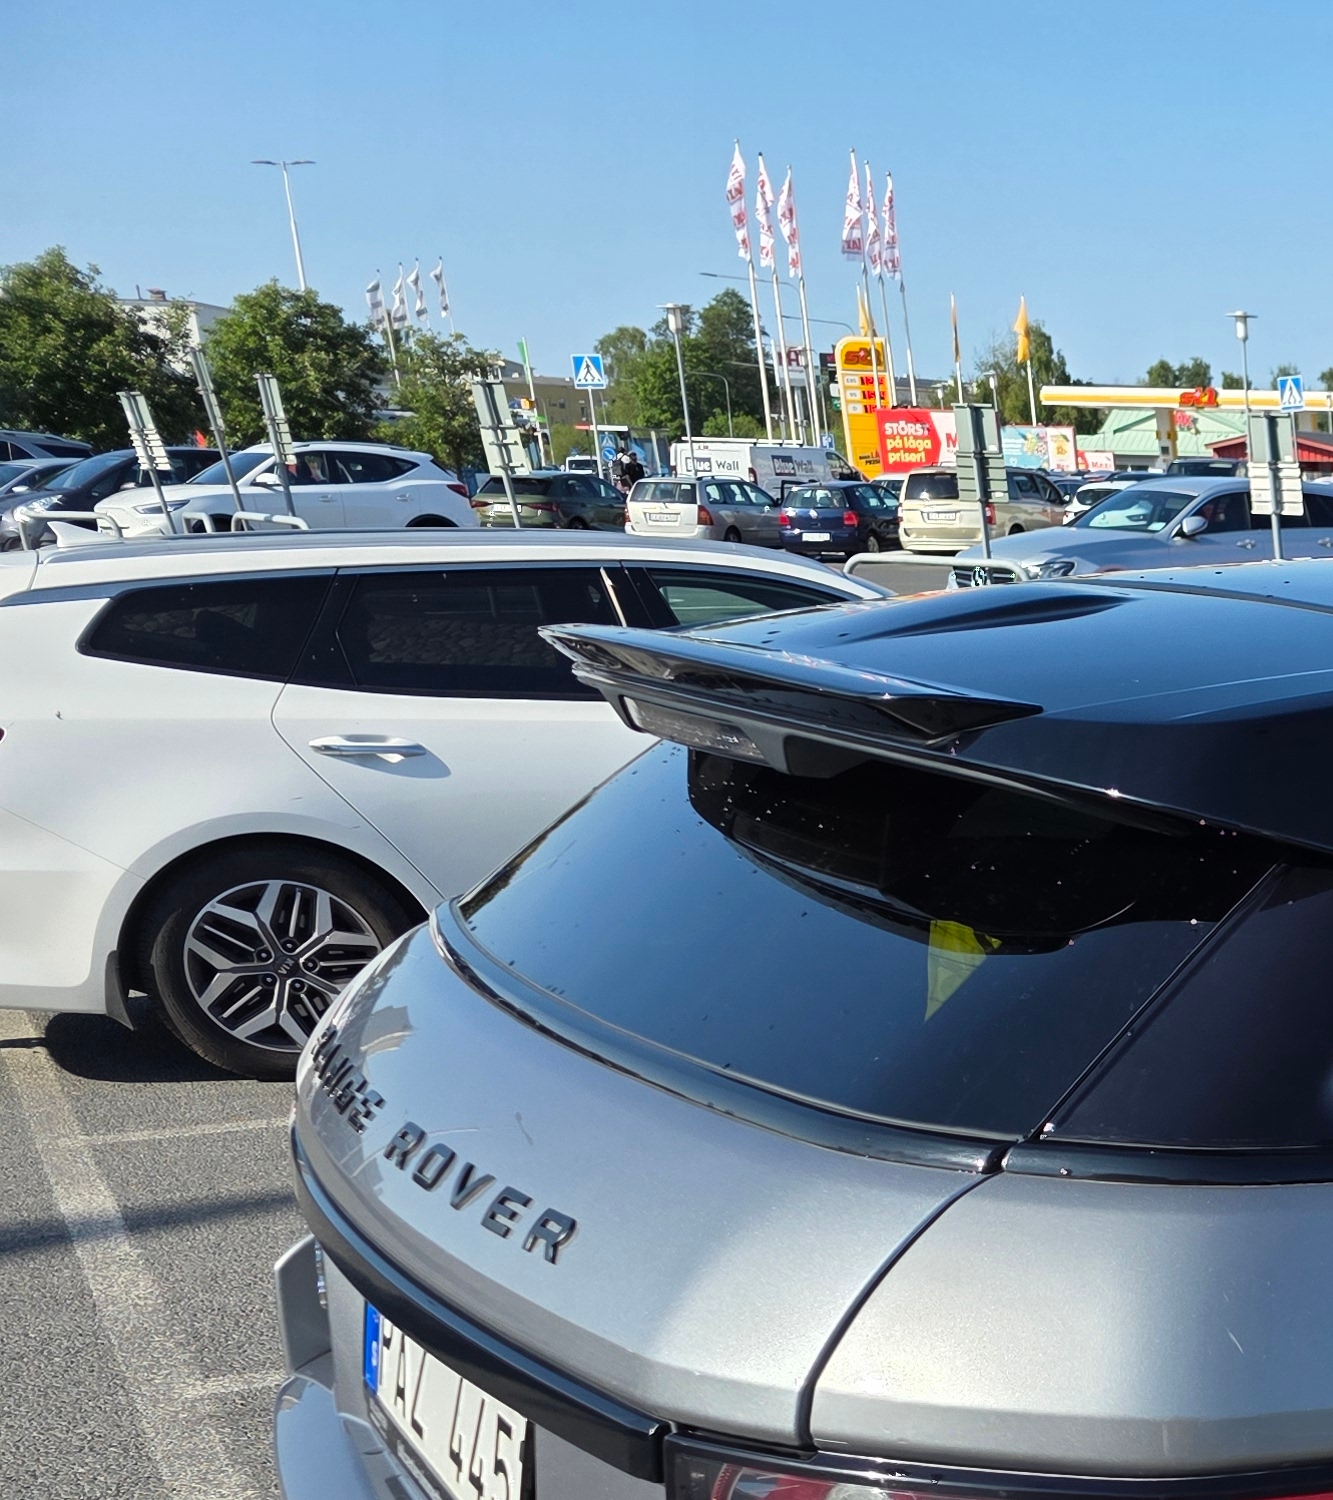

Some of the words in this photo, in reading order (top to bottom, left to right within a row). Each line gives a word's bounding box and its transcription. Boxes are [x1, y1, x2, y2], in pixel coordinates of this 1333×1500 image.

[885, 421, 929, 435] STÖRST
[887, 436, 903, 449] på
[904, 436, 932, 449] låga
[686, 458, 711, 472] Blue
[715, 460, 740, 471] Wall
[773, 458, 795, 475] Blue
[383, 1121, 577, 1266] ROVER
